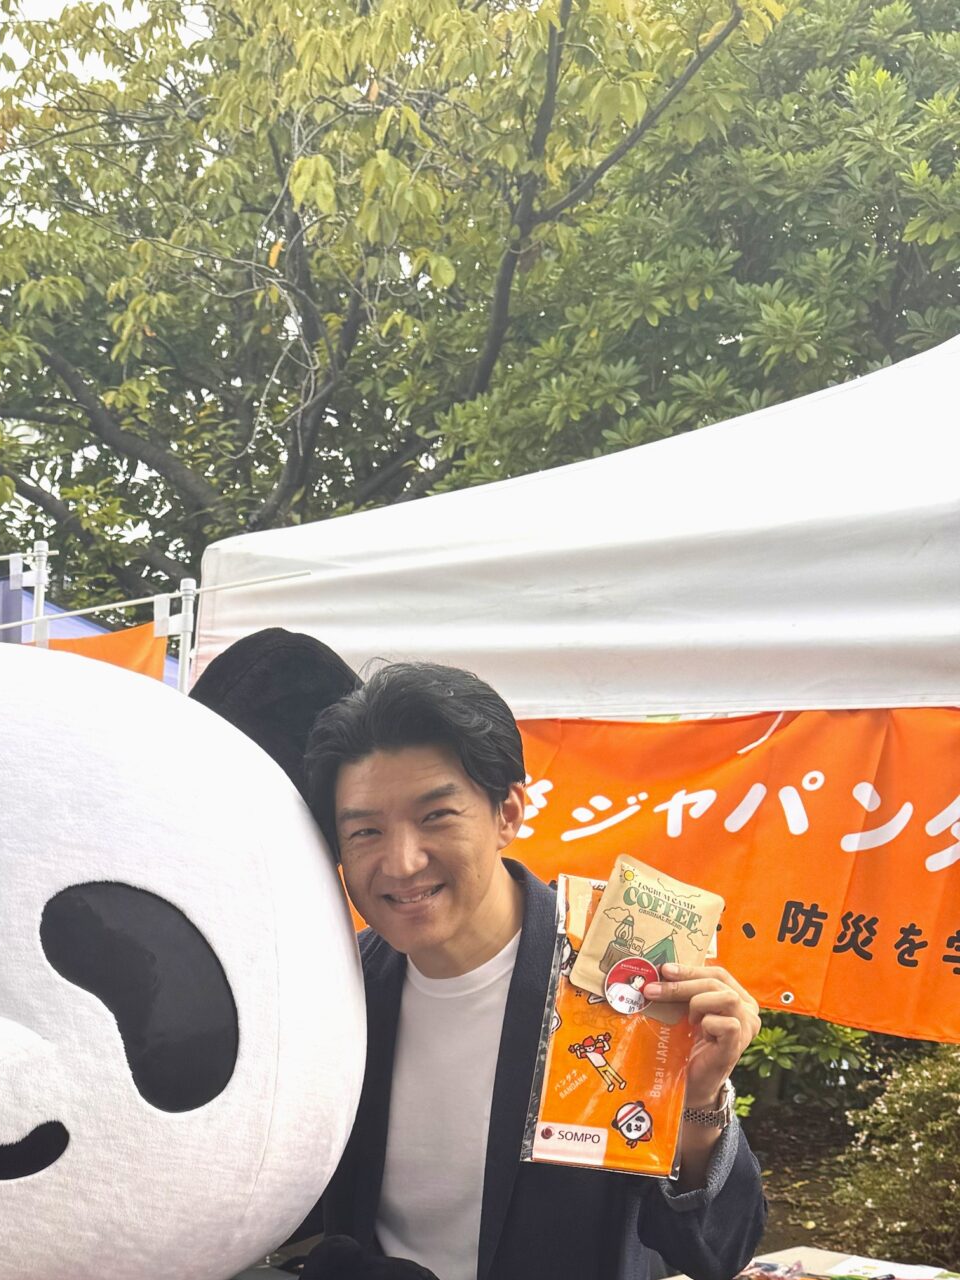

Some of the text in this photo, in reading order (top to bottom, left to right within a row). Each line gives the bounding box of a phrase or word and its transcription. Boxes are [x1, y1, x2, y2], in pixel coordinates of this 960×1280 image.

[623, 886, 703, 933] COFFEE
[650, 1067, 665, 1098] Bosai
[557, 1130, 601, 1144] SOMPO
